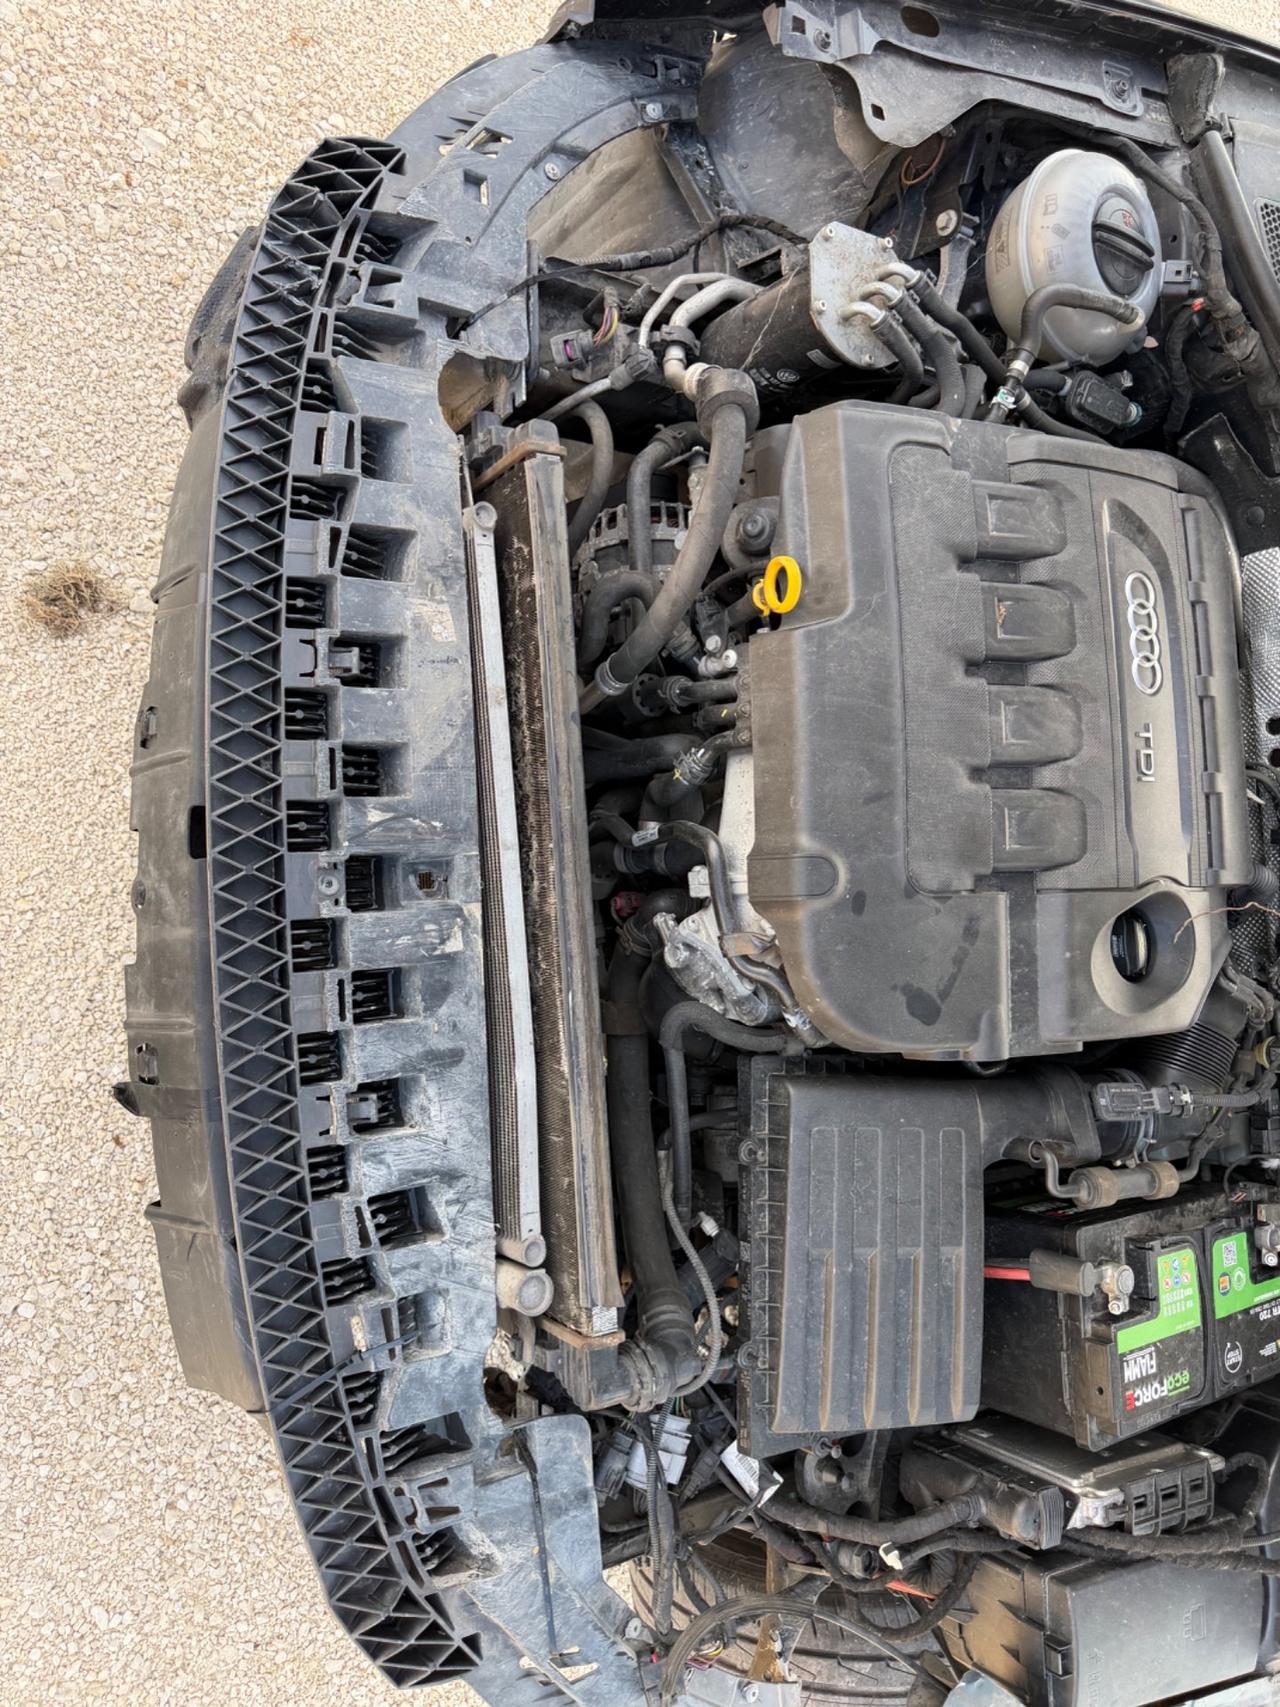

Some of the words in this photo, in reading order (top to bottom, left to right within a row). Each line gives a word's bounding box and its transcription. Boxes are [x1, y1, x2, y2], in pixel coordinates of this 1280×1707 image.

[1134, 723, 1156, 783] TDI
[1123, 1351, 1157, 1384] FIAMM
[1125, 1369, 1190, 1411] ecoFORCE
